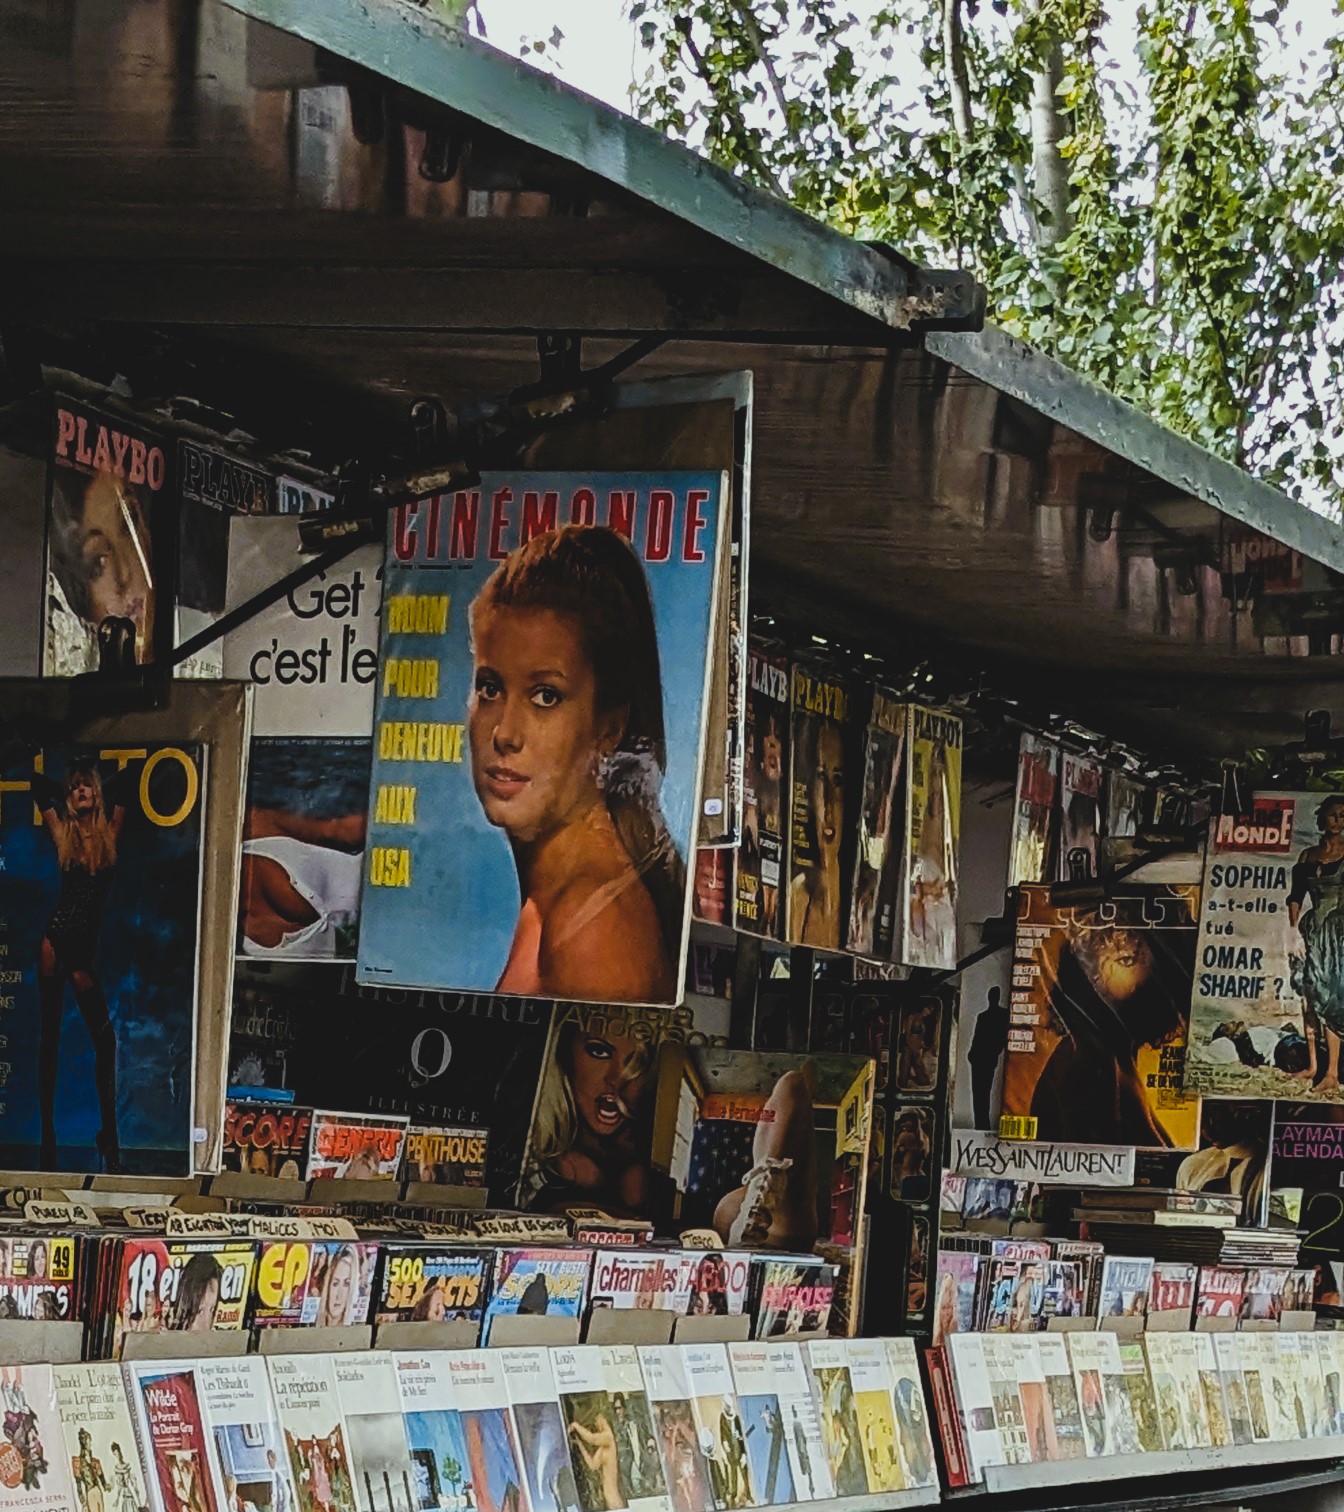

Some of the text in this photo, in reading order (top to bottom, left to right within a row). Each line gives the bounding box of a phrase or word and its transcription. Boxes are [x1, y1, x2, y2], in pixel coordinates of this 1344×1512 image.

[57, 407, 166, 492] PLAYBO
[285, 565, 365, 620] Get
[249, 637, 330, 685] c'est
[385, 658, 441, 700] POUR
[379, 721, 466, 763] DENEUVE
[376, 784, 417, 827] AUX
[1215, 808, 1292, 846] MONDE
[371, 848, 411, 889] USA
[1211, 863, 1287, 891] SOPHIA
[1208, 900, 1278, 914] a-t-elle
[1206, 919, 1234, 936] tué
[1203, 945, 1264, 972] OMAR
[1199, 973, 1266, 1000] SHARIF
[223, 1111, 311, 1150] SCORE
[407, 1135, 487, 1165] PENTHOUSE
[52, 1245, 70, 1268] 49
[389, 1257, 424, 1283] 500
[128, 1252, 158, 1316] 18
[599, 1257, 678, 1293] charnelles
[386, 1281, 425, 1309] SEX
[145, 1388, 178, 1408] Wilde
